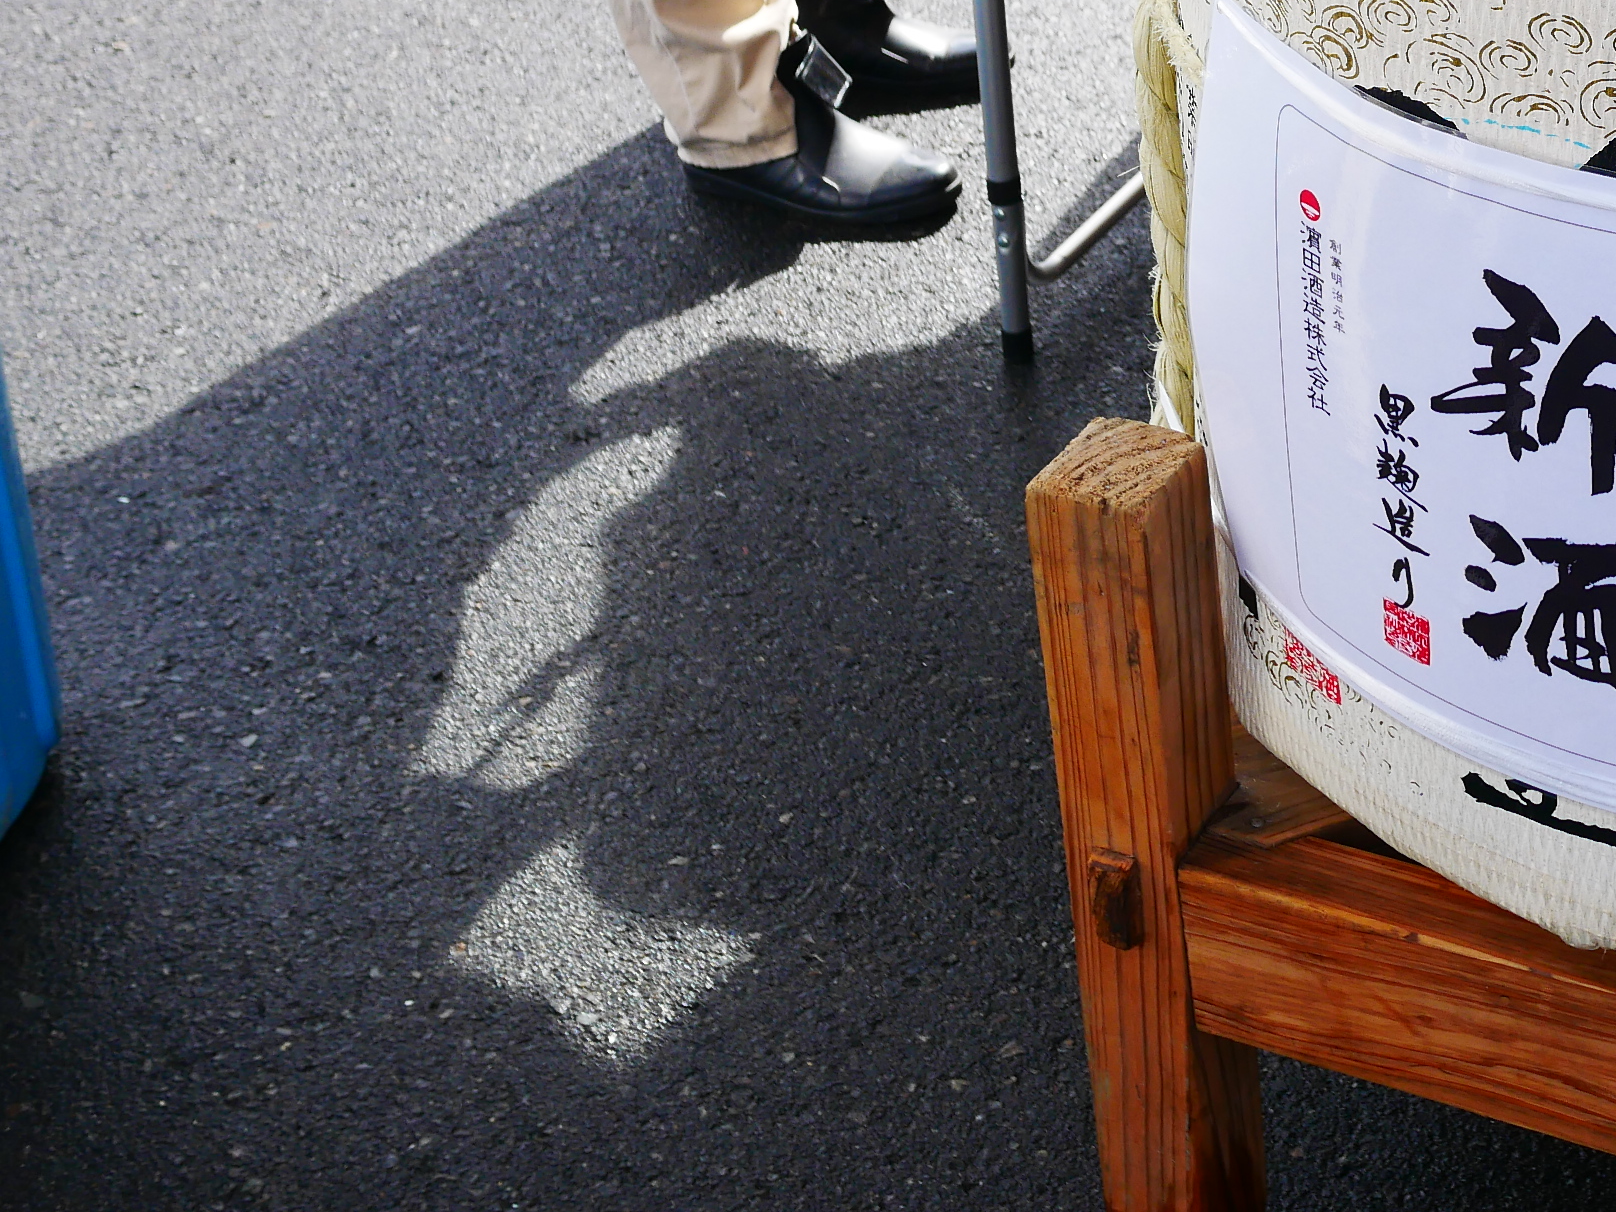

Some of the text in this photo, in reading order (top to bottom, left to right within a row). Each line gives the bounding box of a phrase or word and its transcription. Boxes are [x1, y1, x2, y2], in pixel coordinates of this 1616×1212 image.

[1299, 219, 1333, 418] 濱田酒造株式会社
[1328, 238, 1347, 334] 創業明治元年
